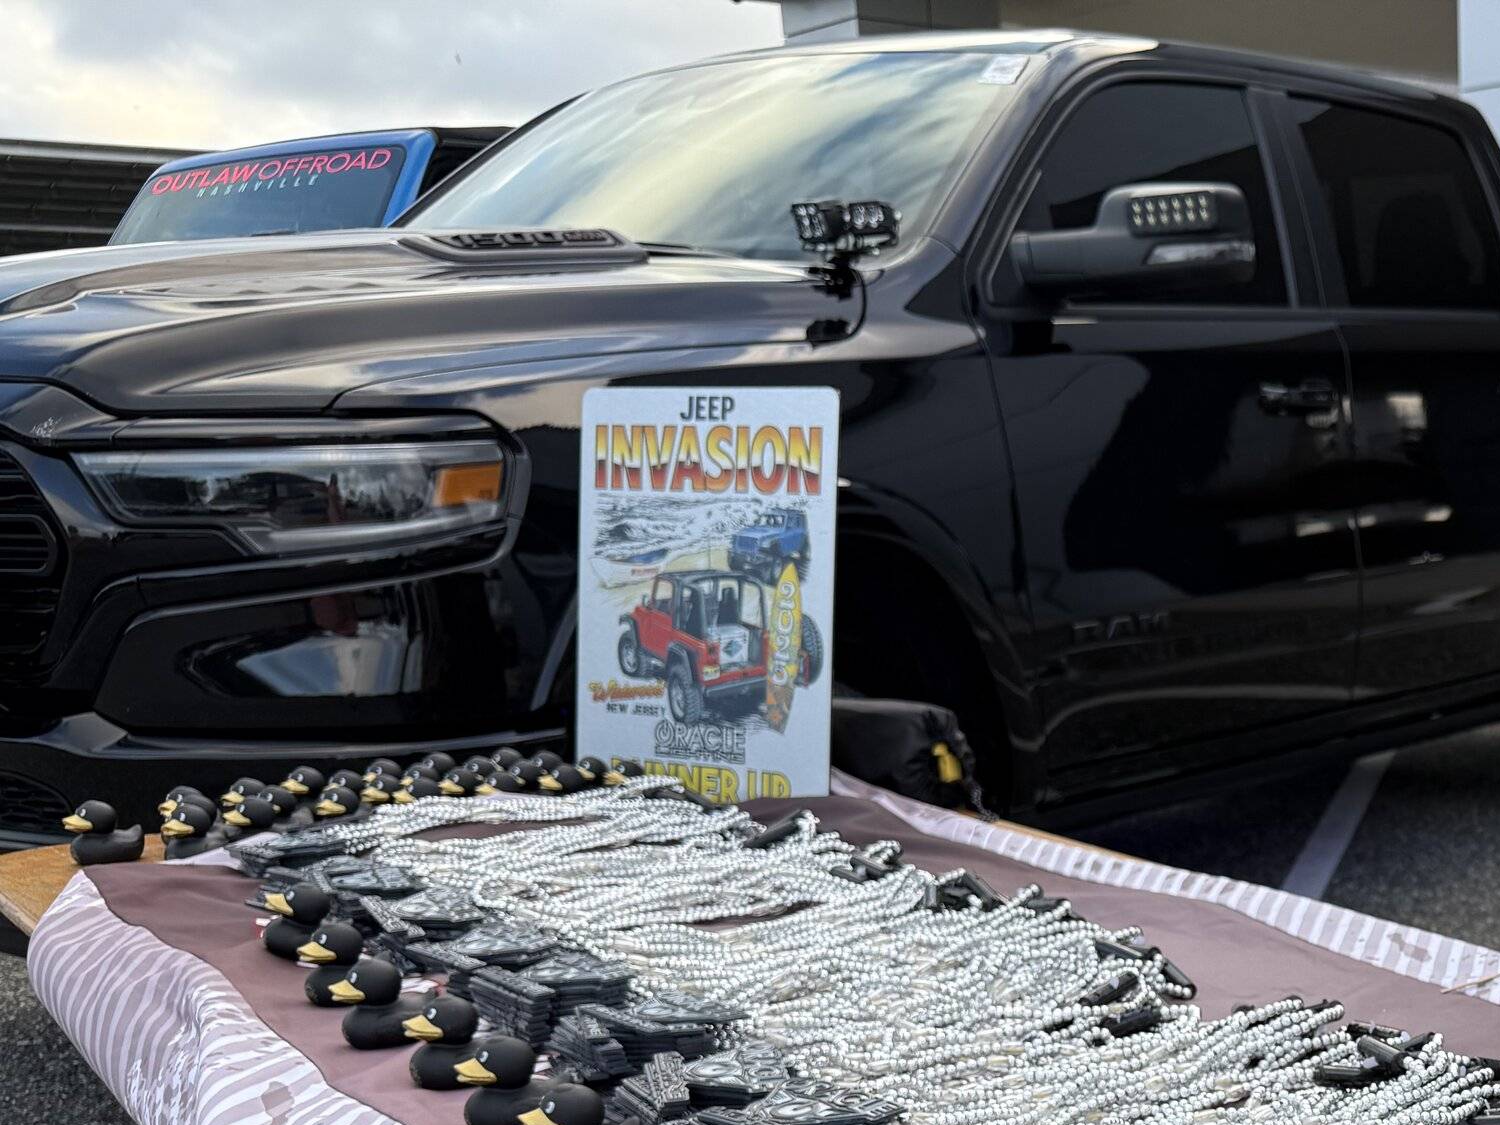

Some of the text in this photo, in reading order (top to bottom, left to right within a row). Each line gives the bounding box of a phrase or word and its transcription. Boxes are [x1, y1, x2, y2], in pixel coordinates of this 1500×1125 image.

[196, 175, 320, 198] NASHVILLE
[680, 396, 735, 420] JEEP
[594, 424, 823, 496] INVASION
[655, 719, 746, 753] ORACLE
